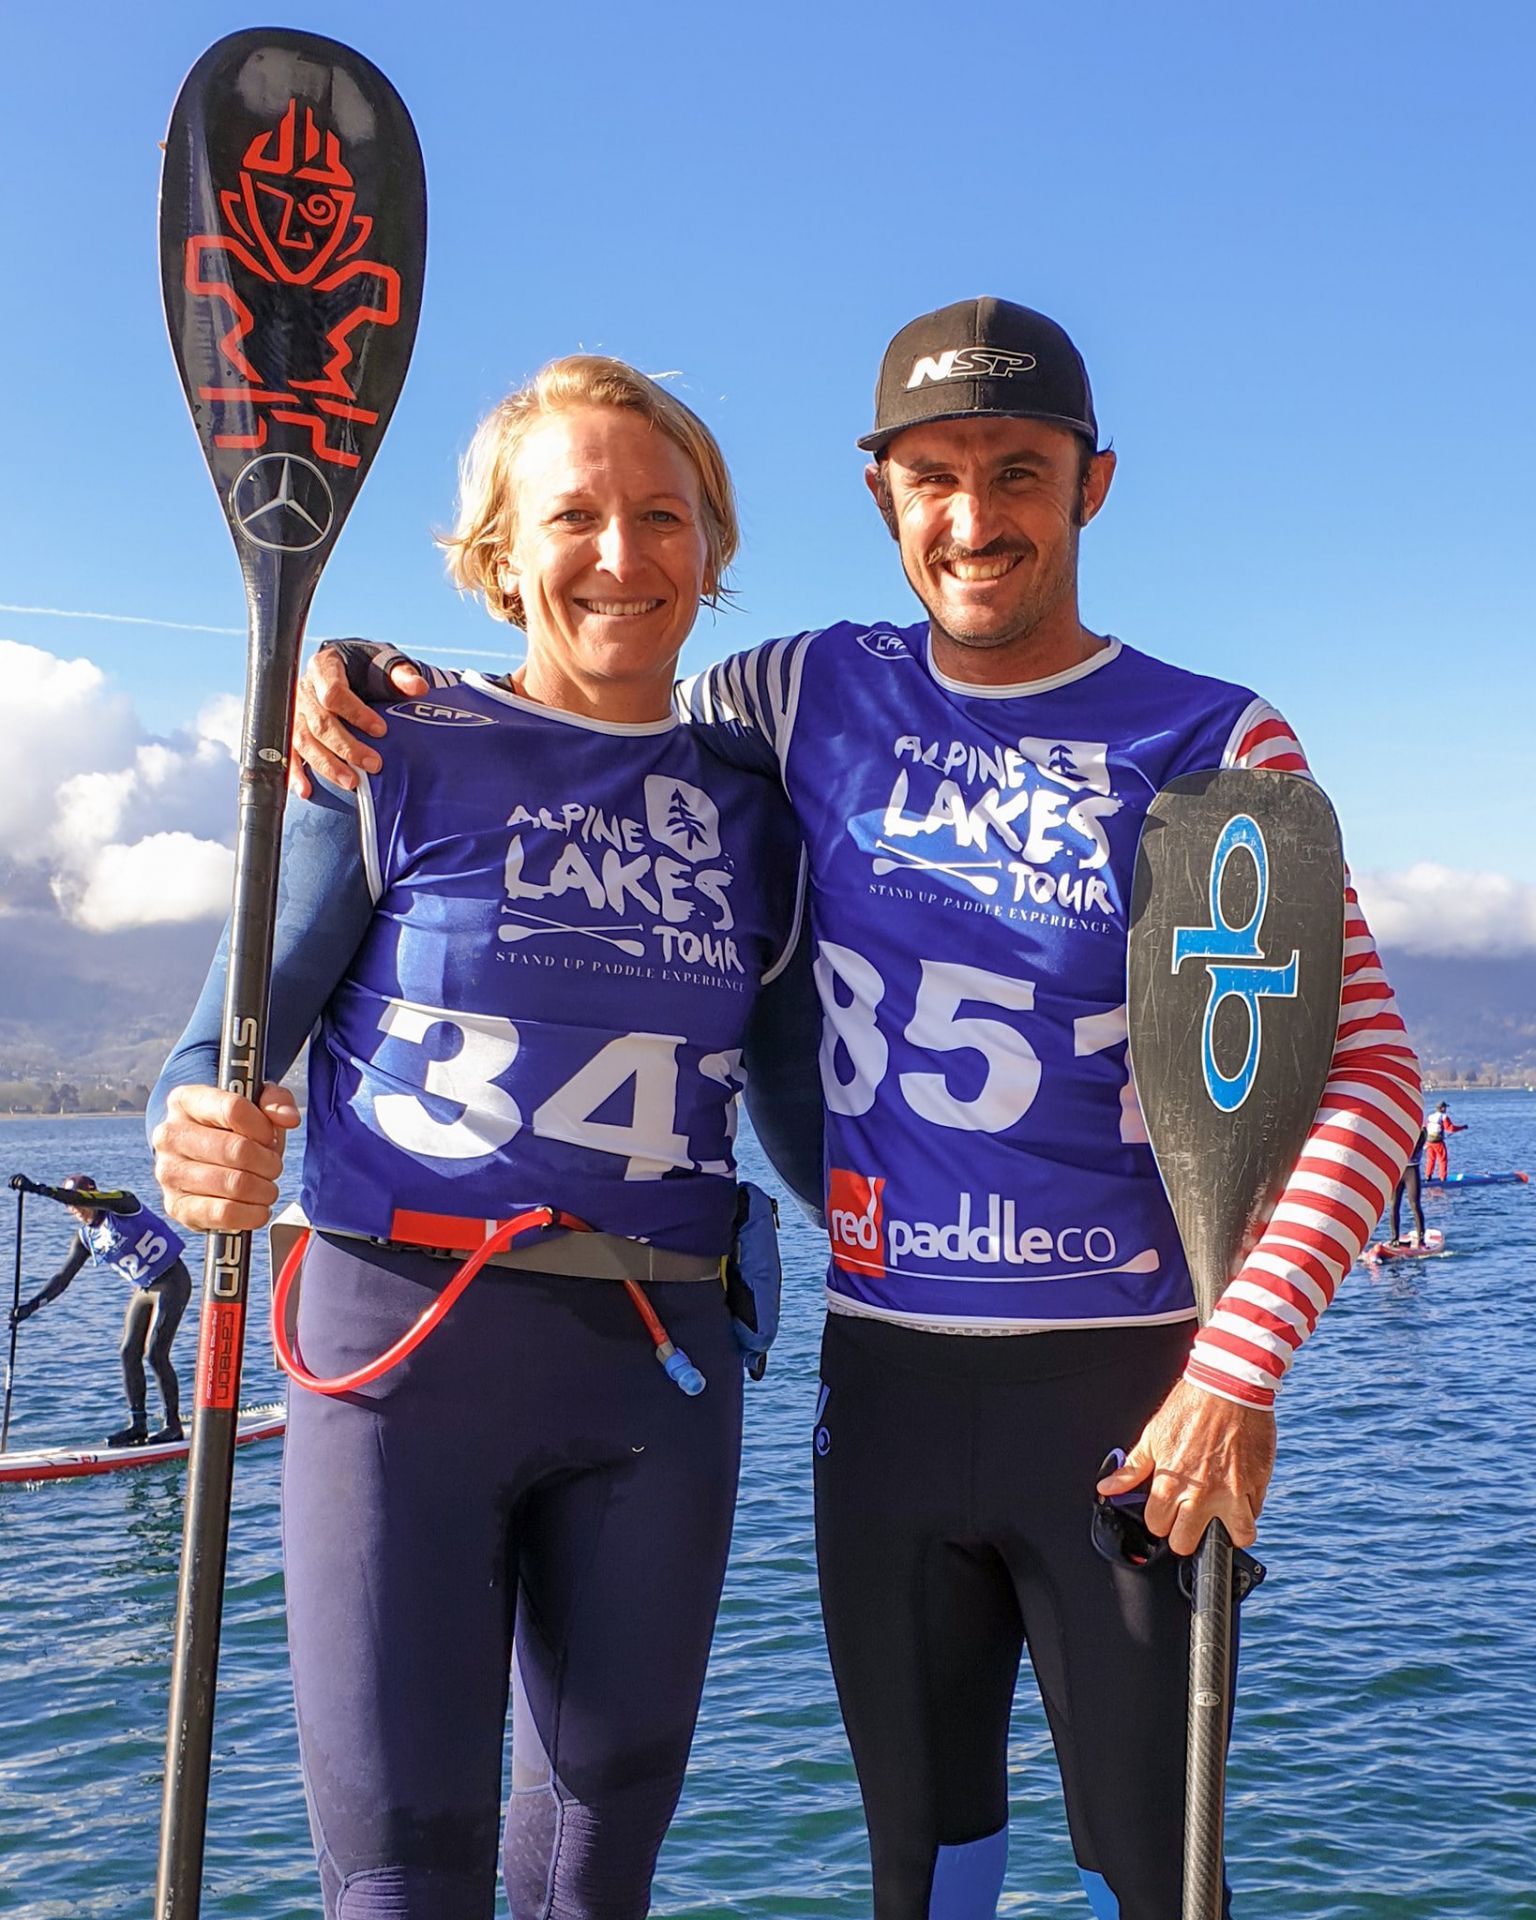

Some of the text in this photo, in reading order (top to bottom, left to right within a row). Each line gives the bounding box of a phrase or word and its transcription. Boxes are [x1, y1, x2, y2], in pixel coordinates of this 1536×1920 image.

[906, 346, 1036, 389] NSP
[893, 735, 1026, 789] ALPINE
[506, 803, 645, 853] ALPINE
[883, 768, 1123, 870] LAKES
[505, 834, 735, 931] LAKES
[1007, 862, 1115, 915] TOUR
[869, 883, 1112, 935] STAND UP PADDLE EXPERIENCE
[496, 951, 746, 993] STAND UP PADDLE EXPERIENCE
[652, 925, 746, 974] TOUR
[832, 1177, 878, 1251] red
